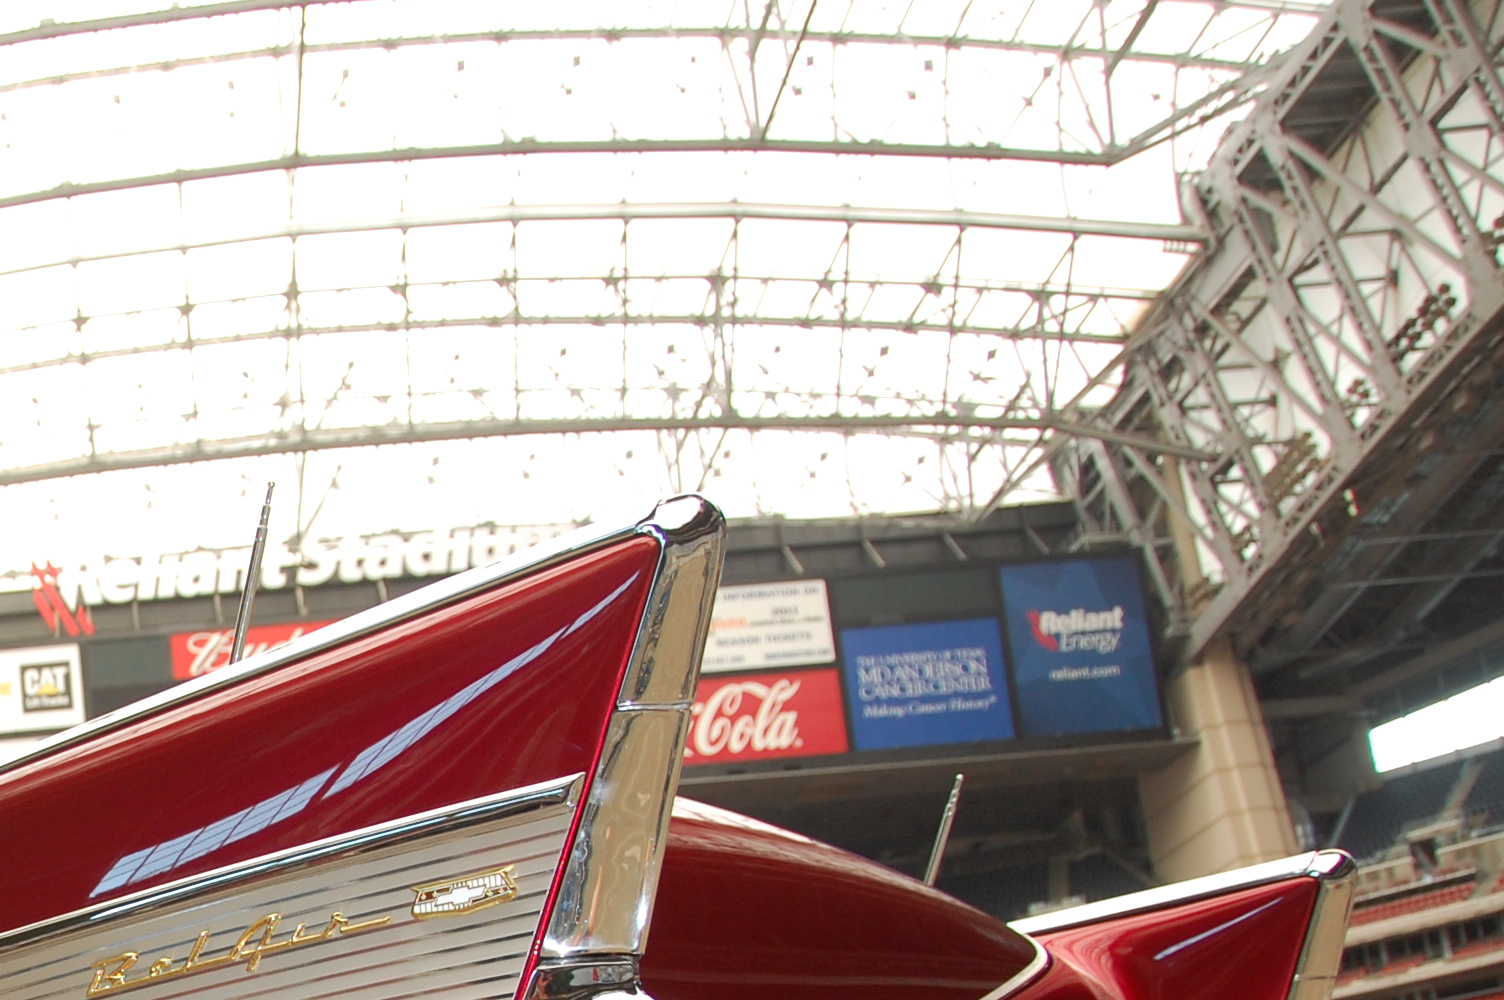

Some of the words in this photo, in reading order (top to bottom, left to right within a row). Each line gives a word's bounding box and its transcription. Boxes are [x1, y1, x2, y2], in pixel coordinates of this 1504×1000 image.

[60, 549, 287, 611] Reliant
[1040, 606, 1124, 633] Reliant
[1060, 633, 1121, 653] Energy
[22, 667, 70, 698] CAT
[892, 659, 988, 682] ANDERSON
[1049, 664, 1121, 681] reliant.com
[858, 680, 928, 702] CANCER
[930, 676, 992, 697] CENTER
[86, 930, 216, 998] Bel
[229, 911, 392, 972] Air
